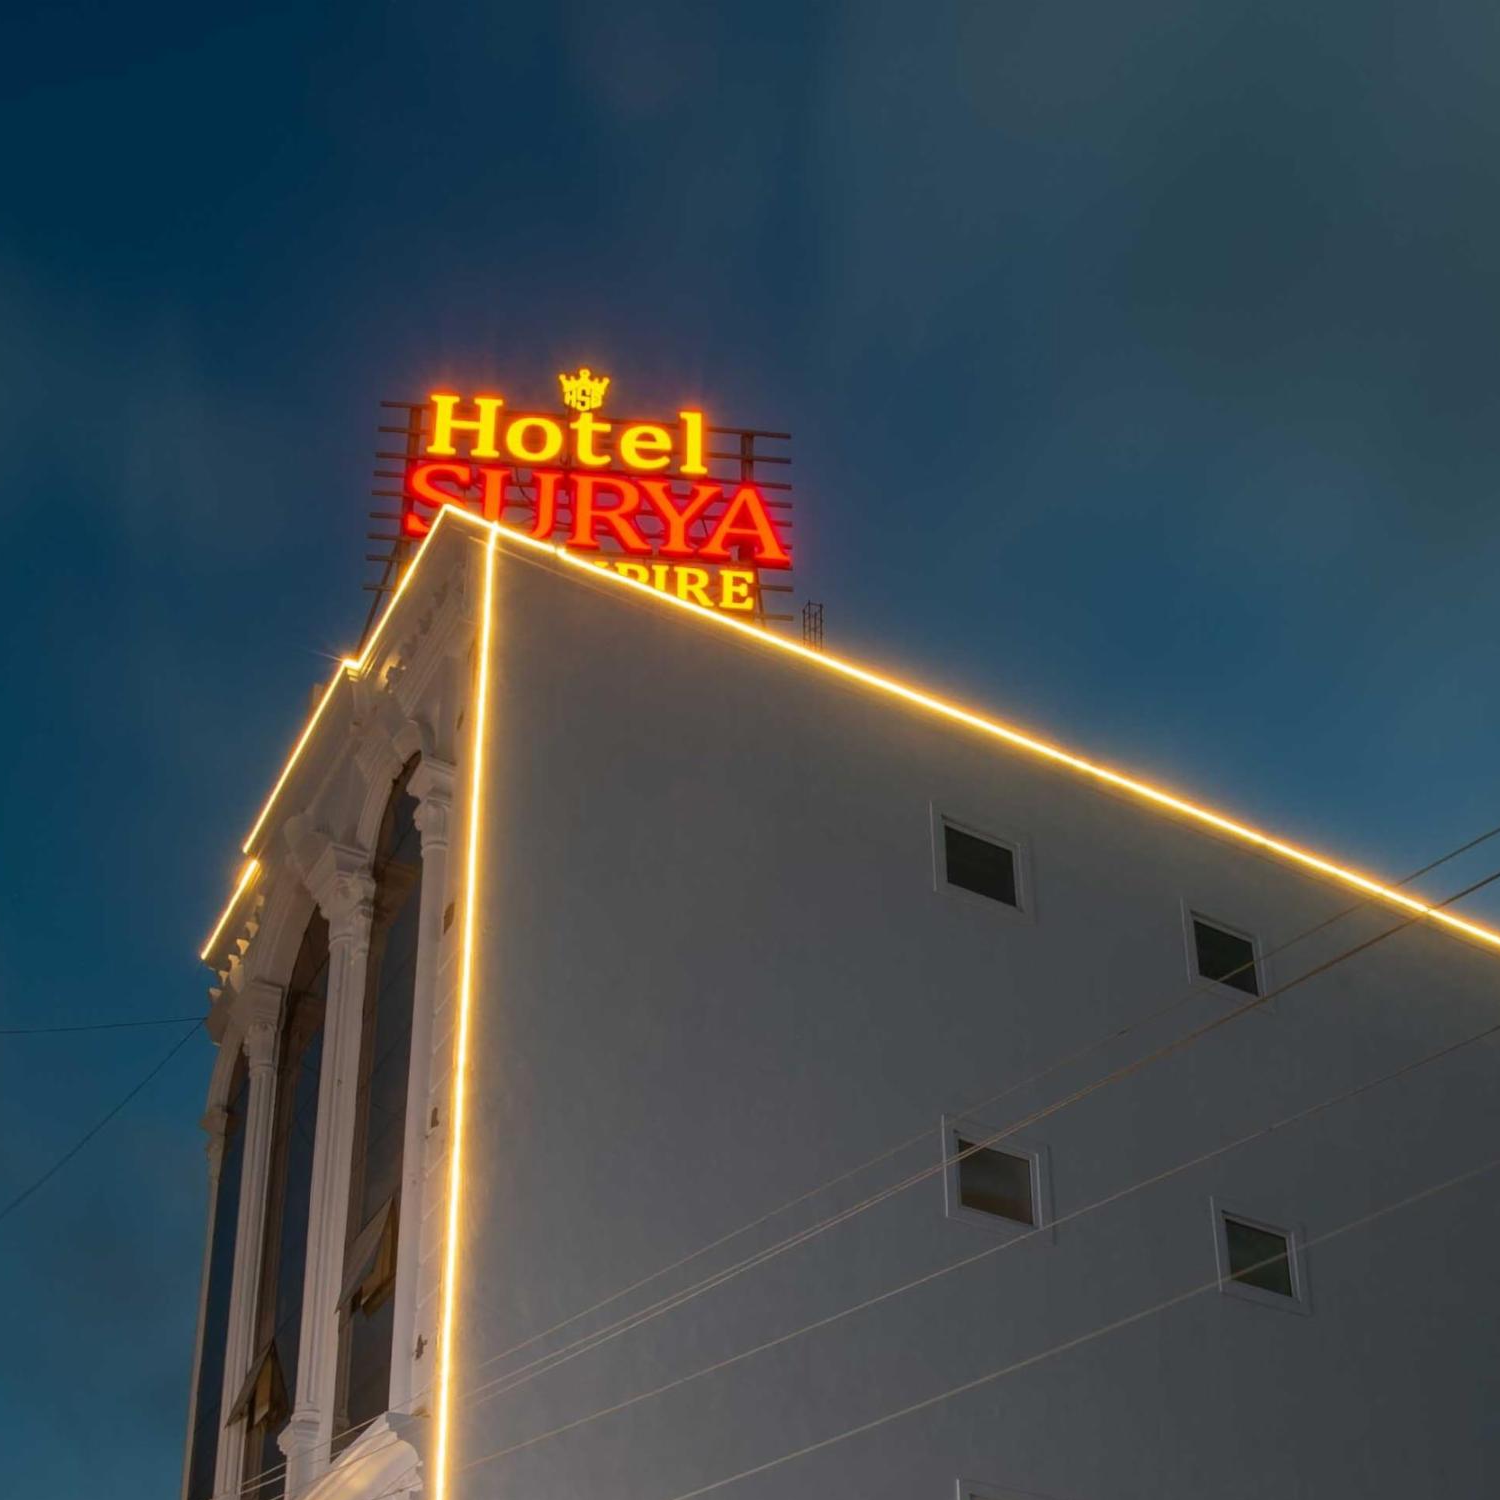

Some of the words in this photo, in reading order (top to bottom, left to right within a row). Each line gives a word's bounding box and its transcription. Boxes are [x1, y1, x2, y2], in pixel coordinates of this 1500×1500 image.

[426, 394, 708, 475] Hotel
[405, 462, 791, 567] SURYA
[594, 560, 755, 611] PIRE
